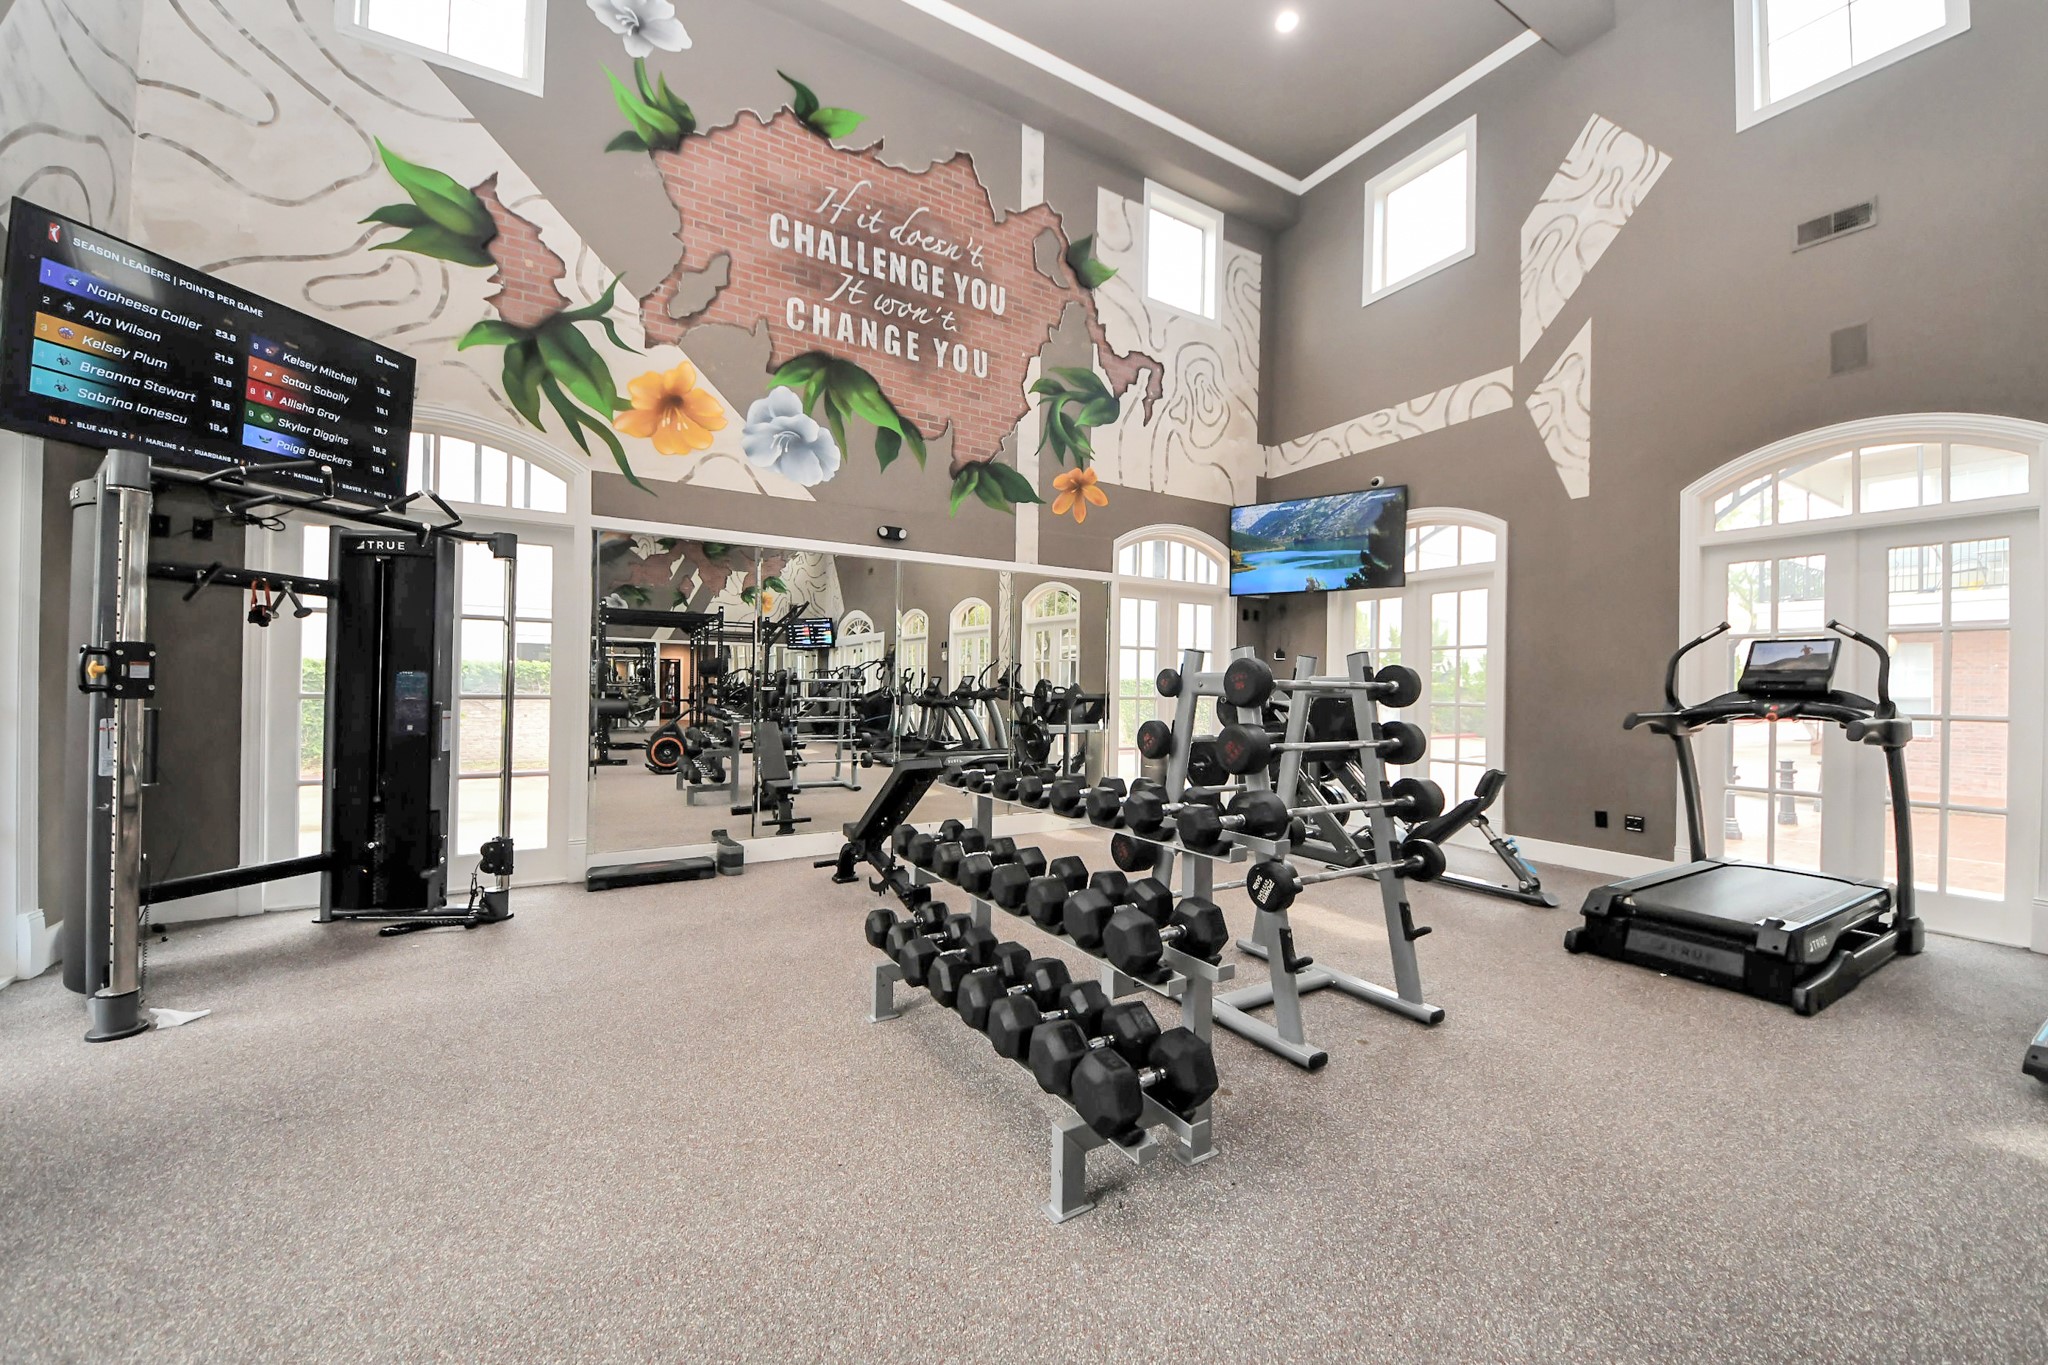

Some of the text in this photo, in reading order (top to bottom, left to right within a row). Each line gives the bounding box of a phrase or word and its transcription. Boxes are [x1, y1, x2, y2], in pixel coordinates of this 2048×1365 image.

[815, 180, 985, 272] If it doesn't
[73, 237, 120, 263] SEASON
[122, 255, 171, 282] LEADERS
[179, 279, 215, 300] POINTS
[217, 293, 236, 307] PER
[237, 301, 264, 318] GAME
[769, 212, 1006, 316] CHALLENGE YOU
[87, 283, 158, 317] Napheesa
[161, 309, 203, 331] Collier
[824, 272, 957, 333] It won't
[42, 296, 234, 365] 2 A'ja Wilson 21.5
[786, 297, 988, 379] CHANGE YOU
[82, 335, 131, 360] Kelsey
[133, 345, 168, 370] Plum
[283, 352, 318, 372] Kelsey
[319, 364, 358, 386] Mitchell
[80, 361, 141, 387] Breanna
[143, 379, 196, 403] Stewart
[281, 374, 312, 392] Satou
[77, 388, 133, 411] Sabrina
[136, 403, 188, 424] Ionescu
[279, 396, 315, 415] Allisha
[316, 406, 341, 423] Gray
[76, 421, 97, 432] BLUE
[98, 427, 119, 437] JAYS
[145, 438, 177, 450] MARLINS
[194, 449, 231, 463] GUARDIANS
[277, 418, 311, 437] Skylar
[313, 428, 349, 446] Diggins
[276, 439, 305, 456] Paige
[307, 448, 353, 467] Bueckers
[366, 540, 406, 550] TRUE
[1811, 935, 1828, 950] TRUE
